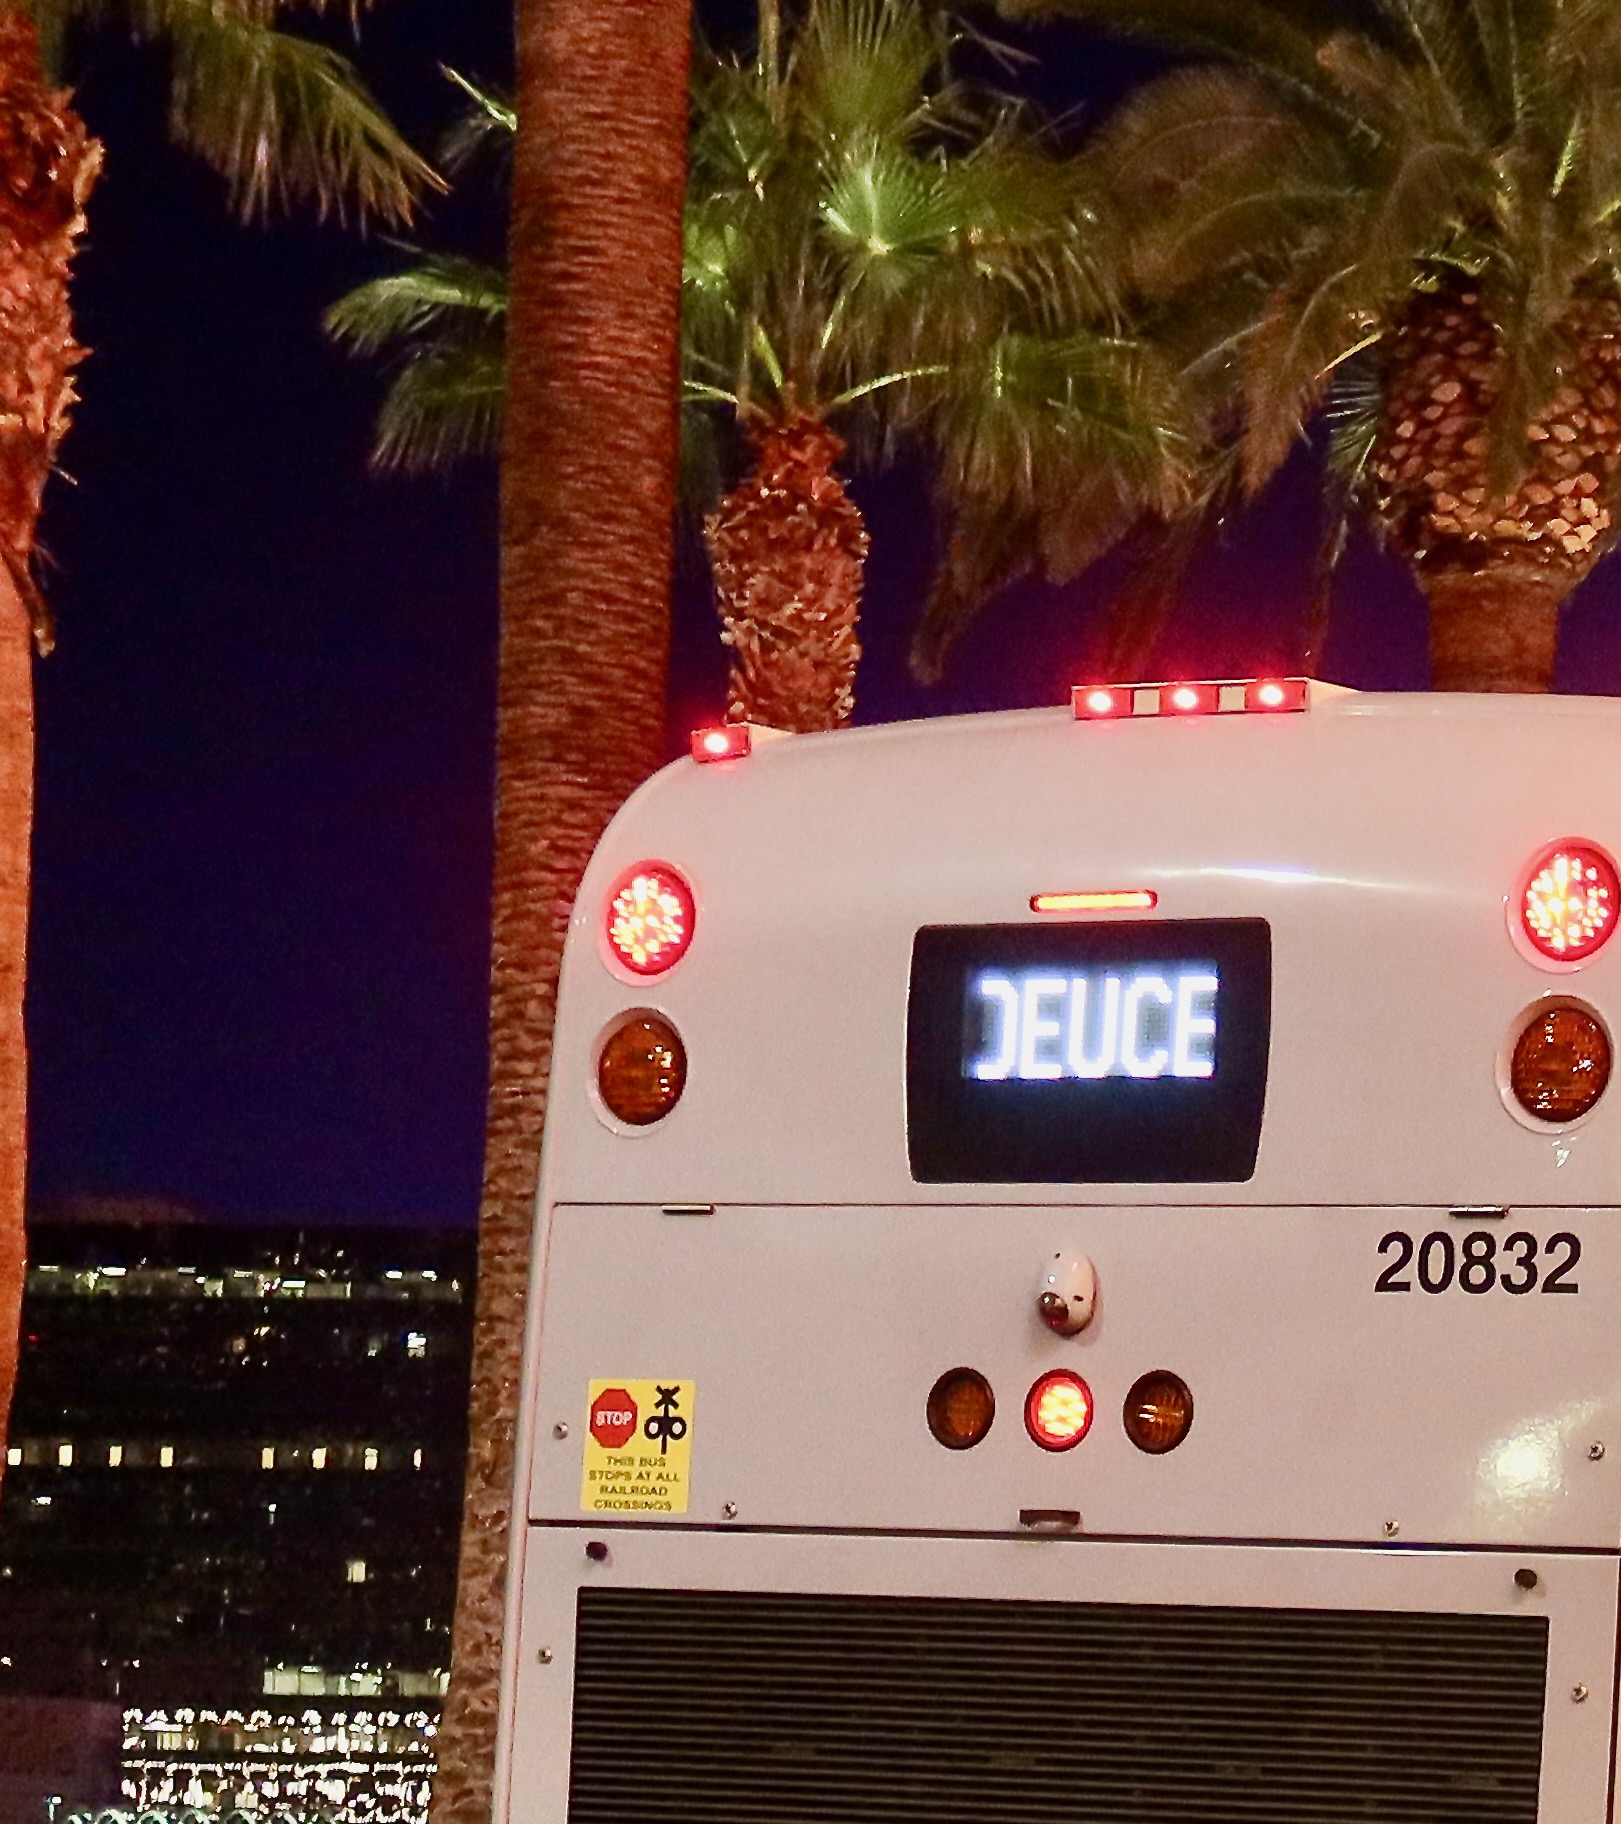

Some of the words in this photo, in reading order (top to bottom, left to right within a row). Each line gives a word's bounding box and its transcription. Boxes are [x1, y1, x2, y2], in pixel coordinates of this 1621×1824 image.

[975, 975, 1219, 1080] DEUCE
[1374, 1230, 1582, 1295] 20832
[595, 1410, 633, 1427] STOP
[606, 1455, 634, 1467] THIS
[638, 1456, 666, 1468] BUS
[588, 1469, 632, 1482] STOPS
[635, 1470, 651, 1481] AT
[655, 1471, 680, 1483] ALL
[599, 1484, 668, 1497] RAILROAD
